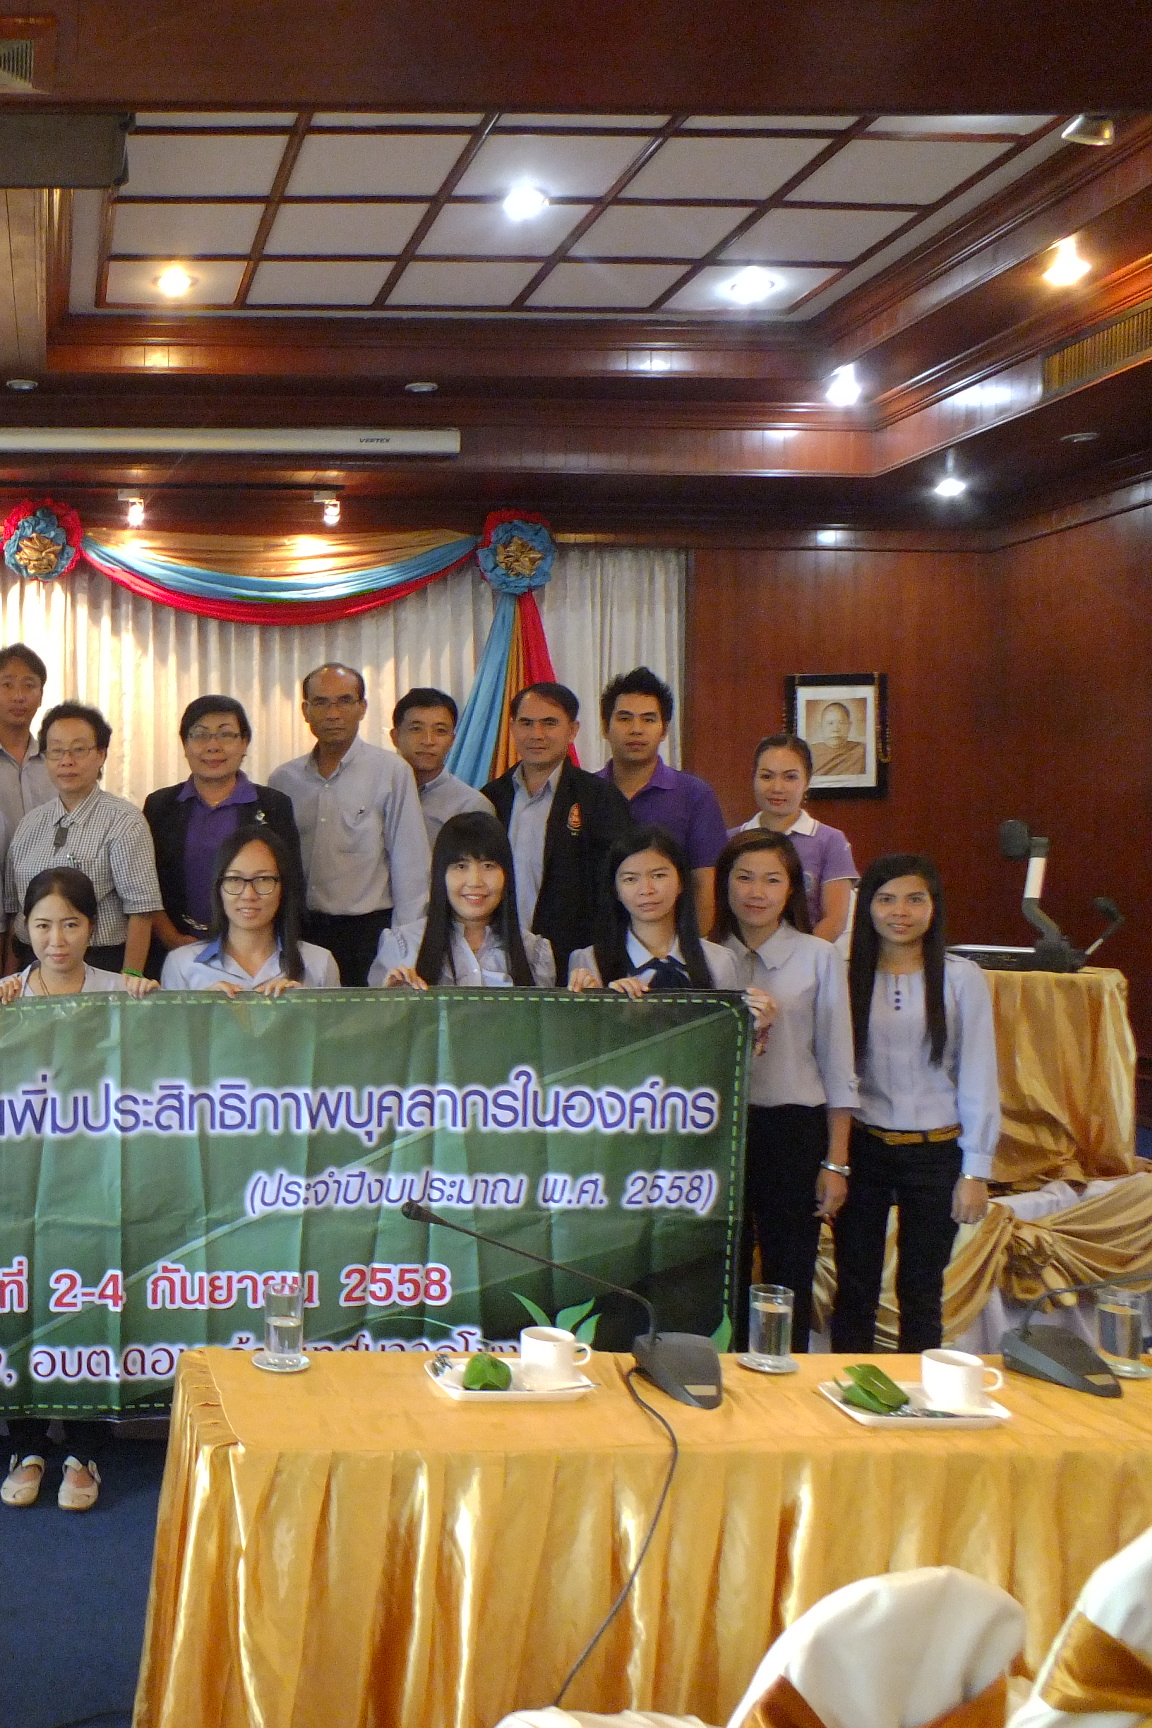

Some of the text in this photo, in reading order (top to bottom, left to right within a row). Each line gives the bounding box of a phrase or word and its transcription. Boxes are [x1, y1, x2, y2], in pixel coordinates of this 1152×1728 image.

[359, 436, 391, 444] VERTEX
[250, 1170, 714, 1214] (ประจำปีงบประมาณ พ.ศ. 2558)
[53, 1272, 124, 1309] 2-4
[343, 1267, 448, 1303] 2558
